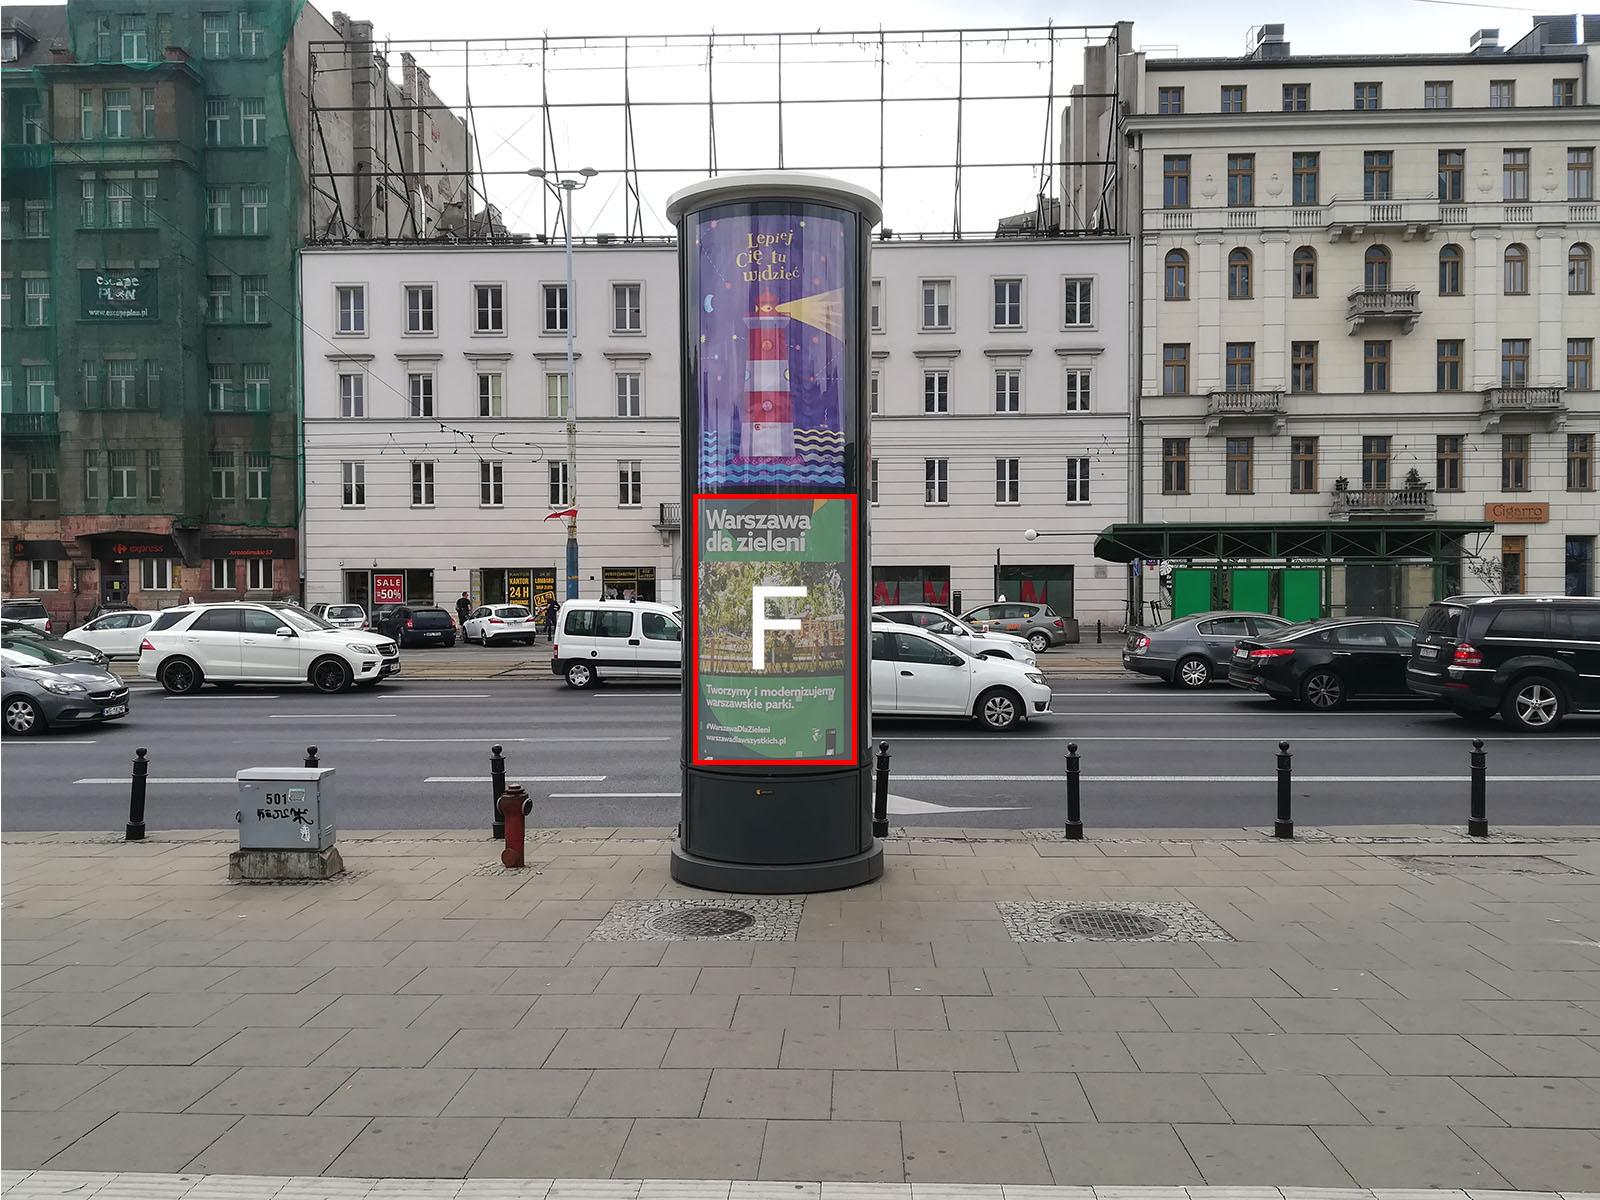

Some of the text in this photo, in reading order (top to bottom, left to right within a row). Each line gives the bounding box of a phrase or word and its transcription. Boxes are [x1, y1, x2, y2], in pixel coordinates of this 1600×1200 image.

[746, 230, 793, 248] Lepiej
[736, 250, 786, 268] Cię tu
[743, 264, 800, 282] widzieć
[1493, 504, 1542, 518] Cigarro
[706, 509, 812, 530] Warszawa
[706, 530, 806, 552] dla zieleni
[376, 579, 401, 587] SALE
[510, 586, 528, 598] 24 H
[706, 684, 836, 699] Tworzymy i modernizujemy
[706, 698, 795, 711] warszawskie parki.
[706, 723, 770, 734] #WarszawaDlaZieleni
[266, 793, 287, 805] 501
